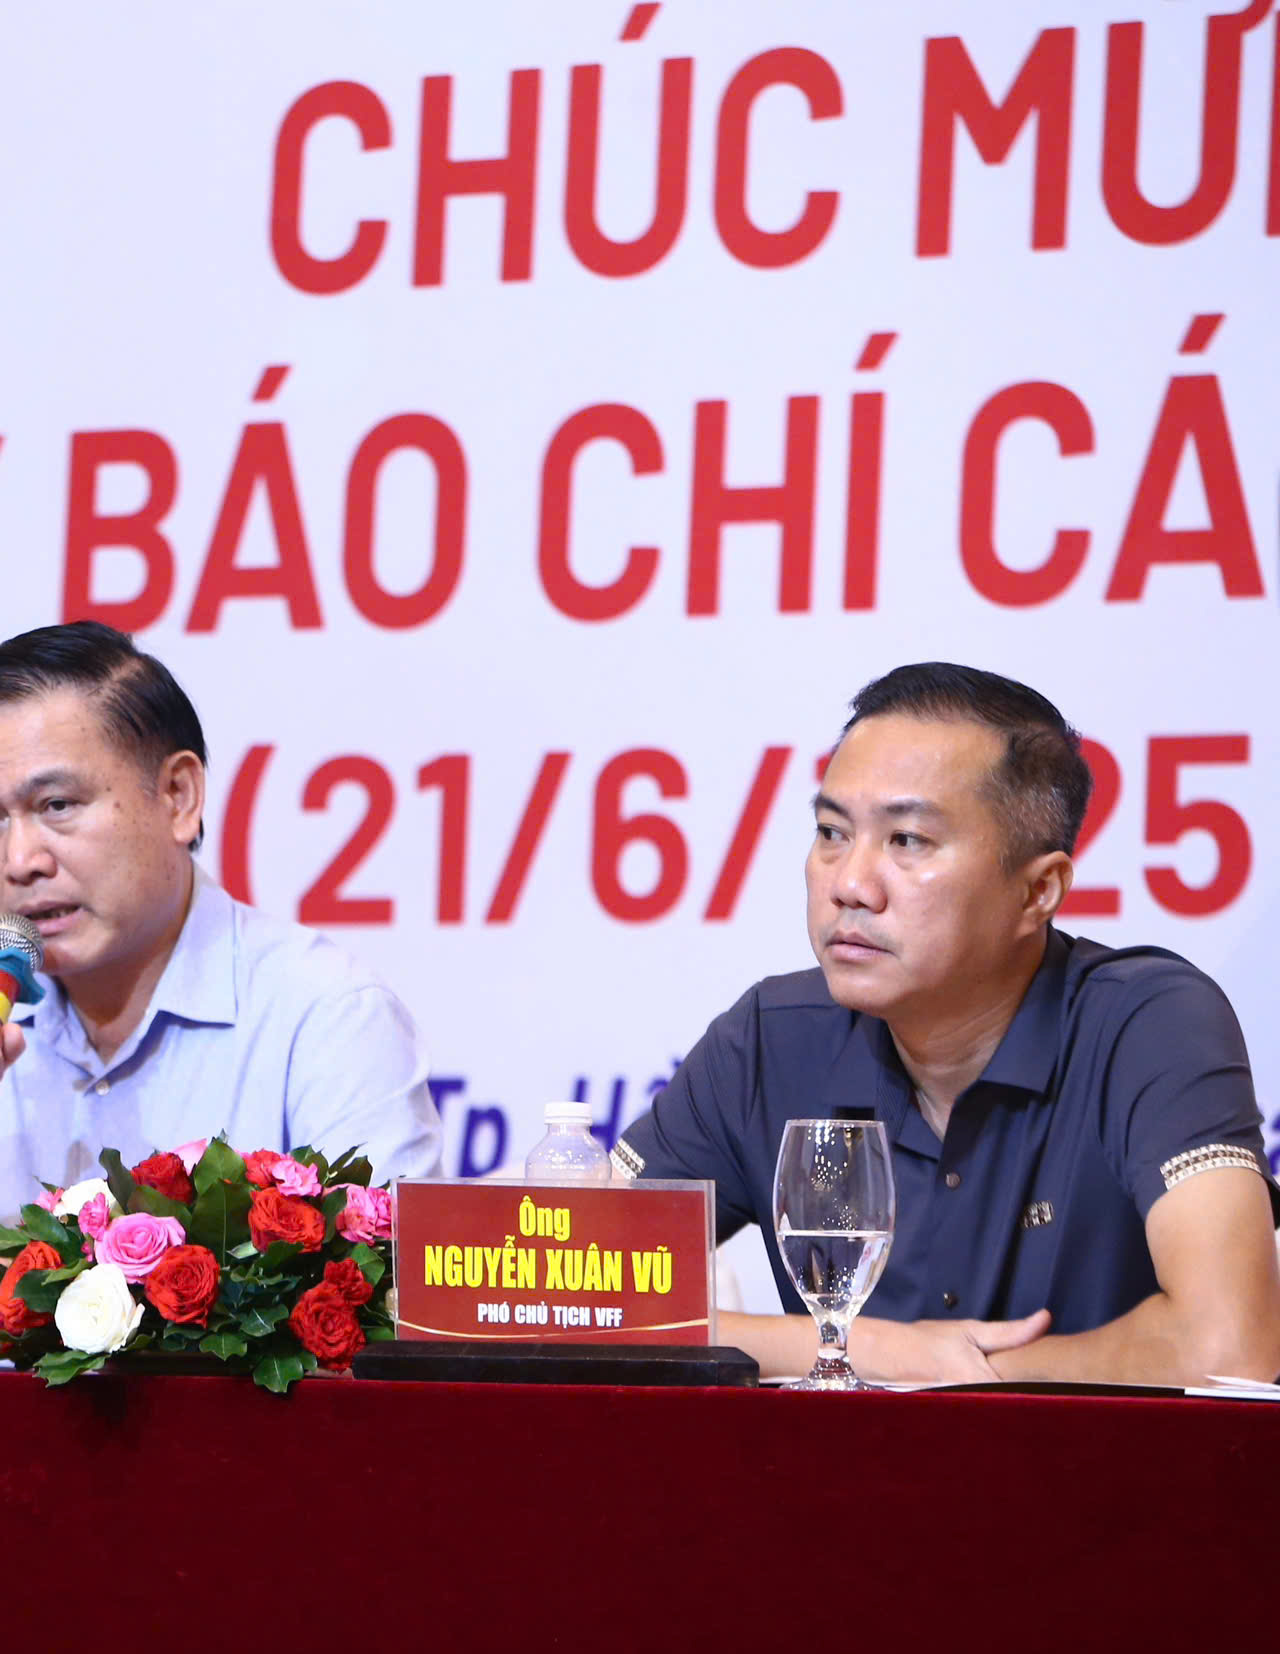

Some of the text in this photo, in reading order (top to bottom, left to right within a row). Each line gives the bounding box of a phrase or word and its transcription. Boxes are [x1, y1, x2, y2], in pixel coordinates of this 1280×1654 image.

[269, 2, 846, 297] CHÚC
[60, 364, 471, 637] BÁO
[536, 330, 899, 625] CHÍ
[958, 312, 1266, 611] CÁ
[218, 734, 1255, 929] (21/6/25
[424, 1235, 673, 1295] NGUYỄN XUÂN VŨ
[518, 1195, 571, 1242] Ông
[477, 1301, 624, 1329] PHÓ CHỦ TỊCH VFF
